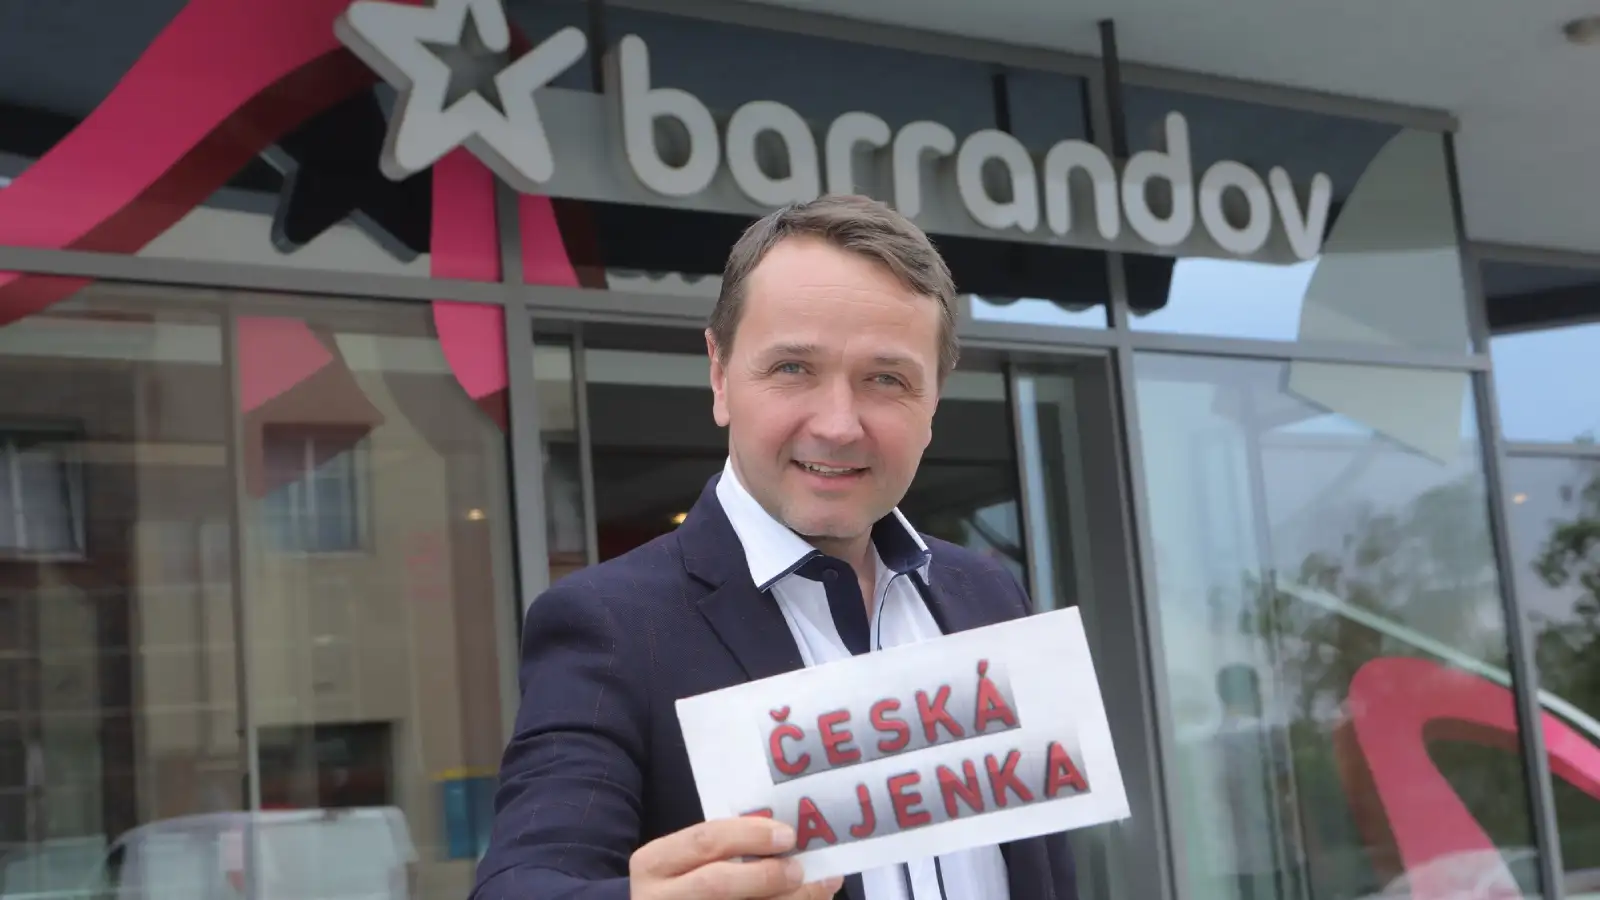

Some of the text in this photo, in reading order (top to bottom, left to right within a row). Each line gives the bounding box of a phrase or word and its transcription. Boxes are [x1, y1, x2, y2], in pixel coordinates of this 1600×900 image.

[617, 34, 1332, 260] barrandov
[768, 658, 1018, 777] ČESKÁ
[740, 740, 1089, 850] AJENKA
